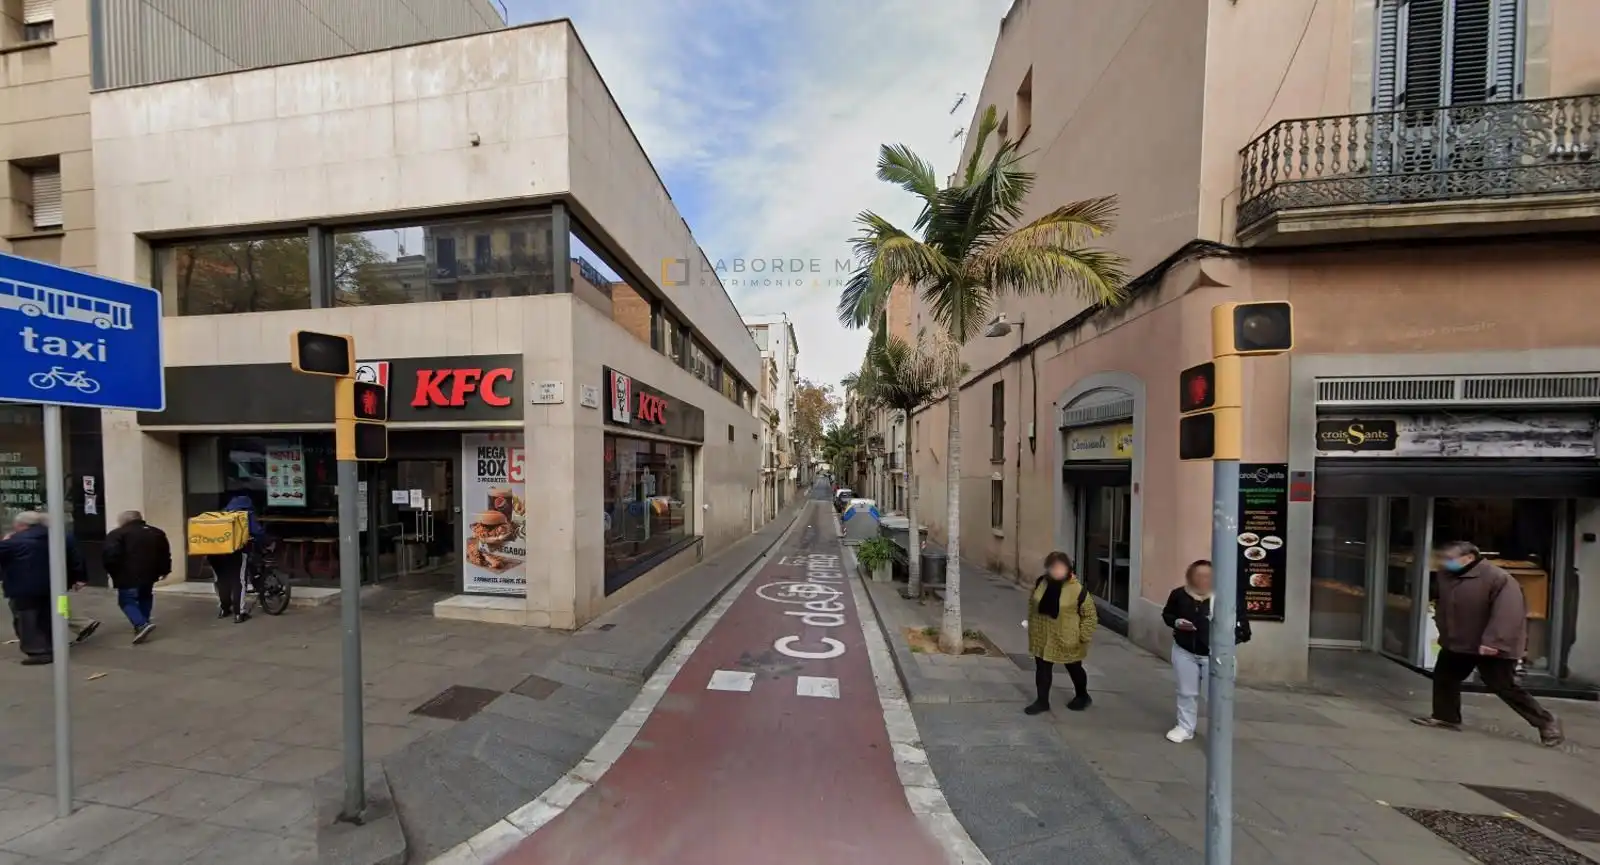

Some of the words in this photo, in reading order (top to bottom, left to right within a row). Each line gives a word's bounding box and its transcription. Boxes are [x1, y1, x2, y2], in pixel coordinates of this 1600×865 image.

[19, 326, 107, 362] taxi
[410, 367, 515, 408] KFC
[637, 391, 668, 426] KFC
[477, 446, 506, 459] MEGA
[477, 459, 506, 476] BOX
[774, 635, 846, 659] C
